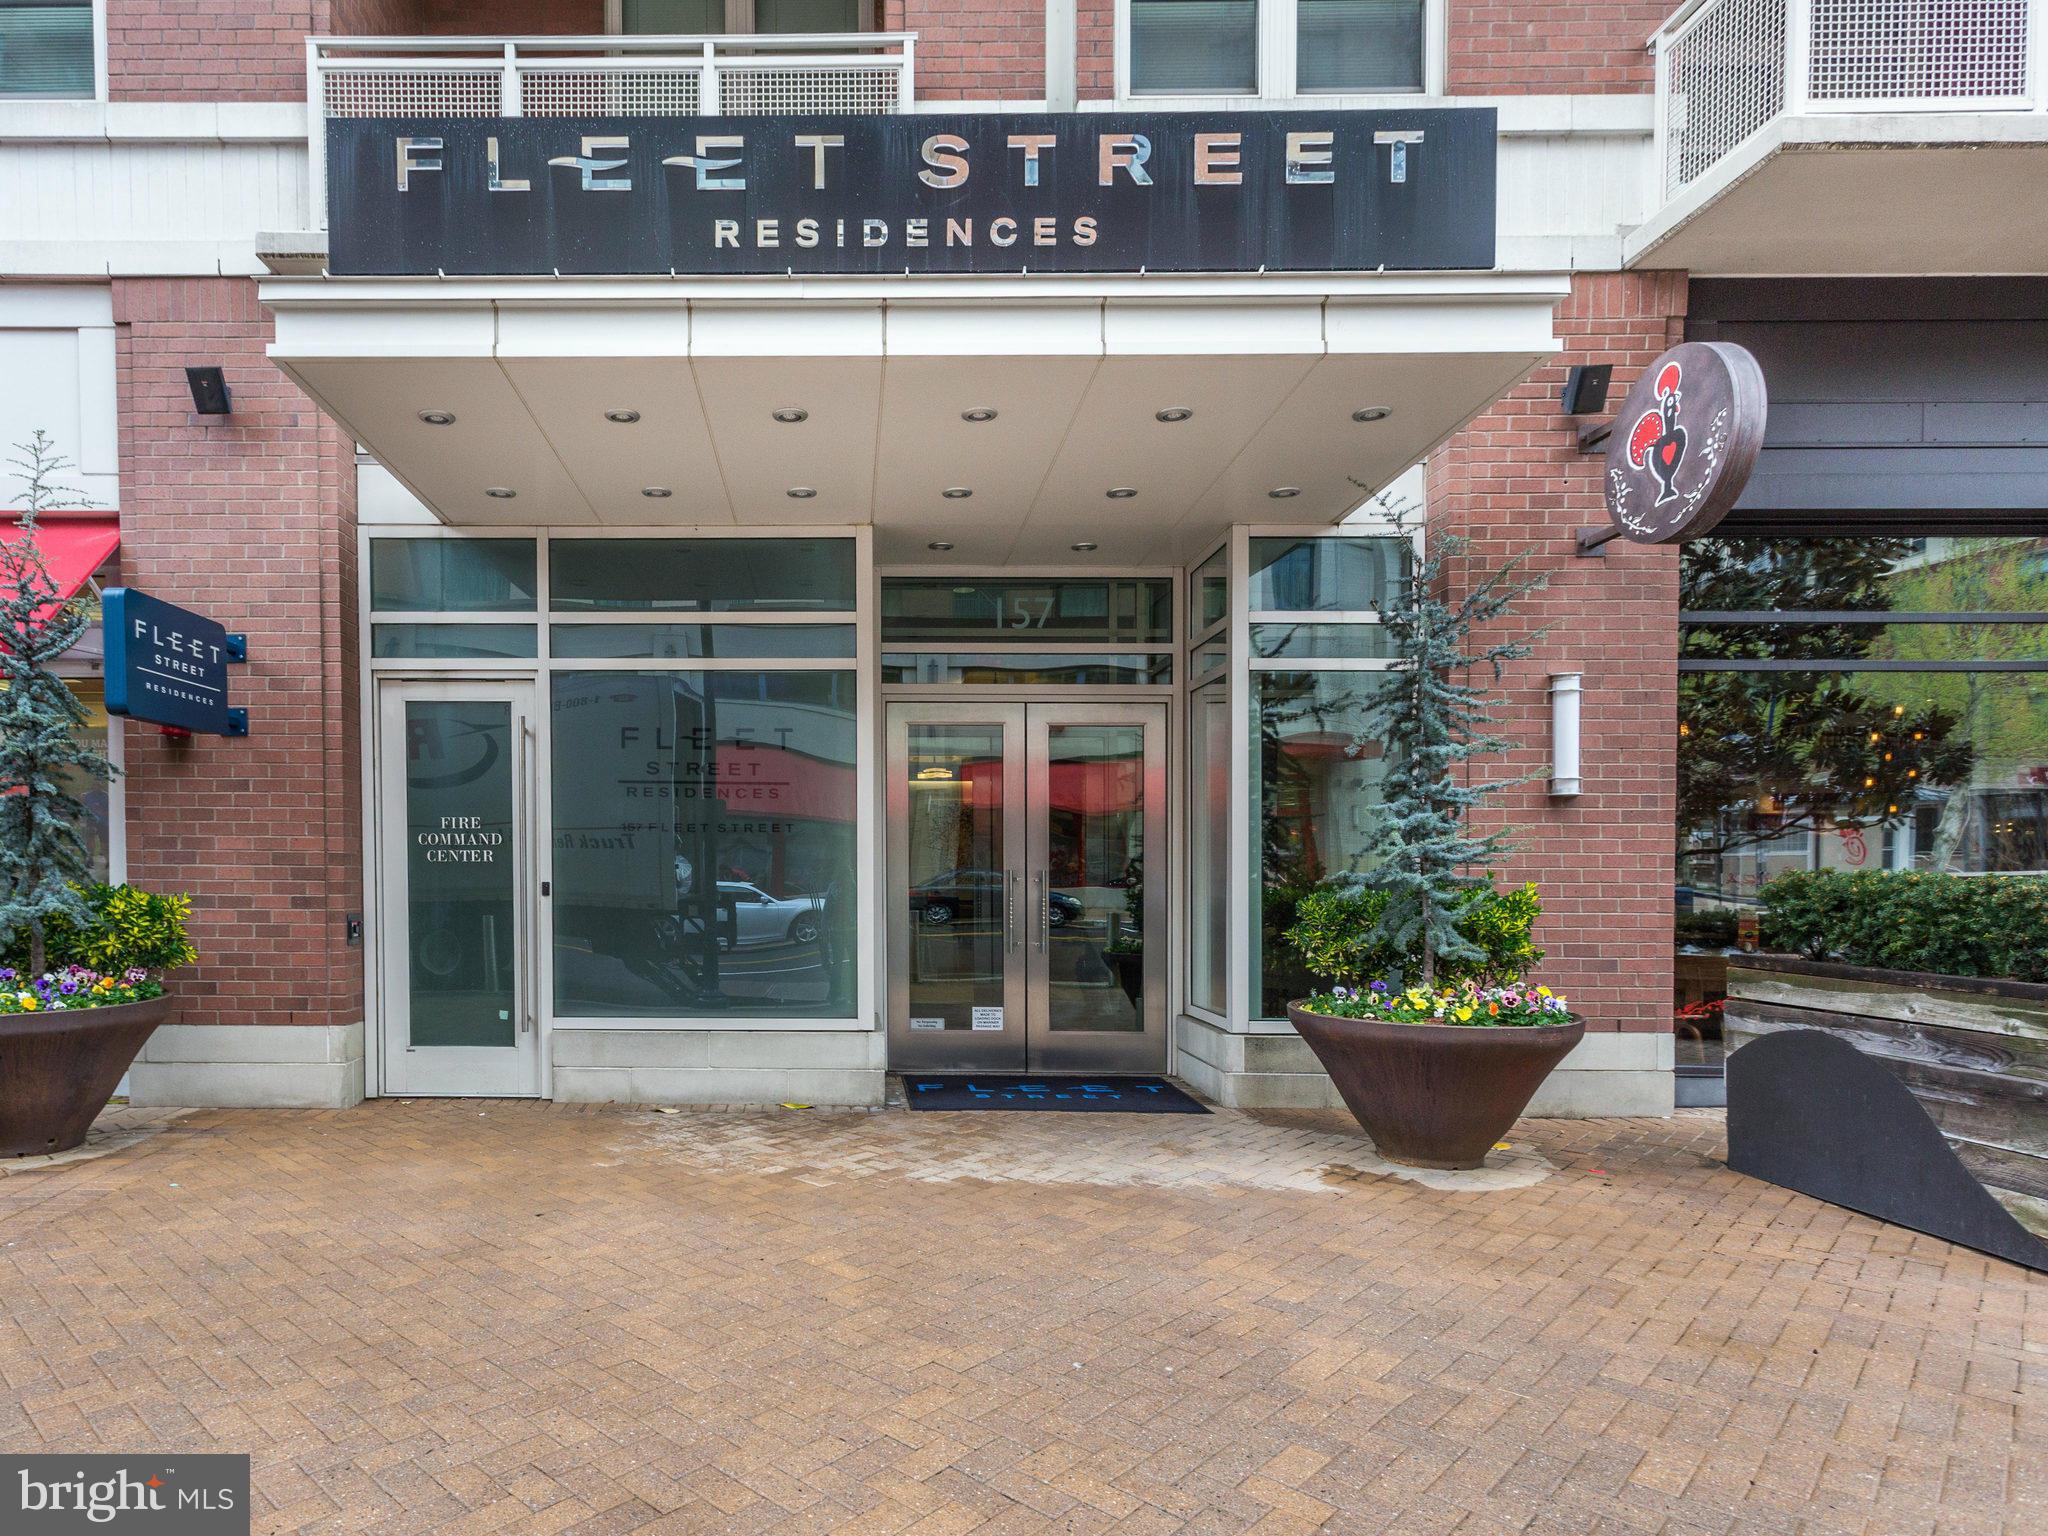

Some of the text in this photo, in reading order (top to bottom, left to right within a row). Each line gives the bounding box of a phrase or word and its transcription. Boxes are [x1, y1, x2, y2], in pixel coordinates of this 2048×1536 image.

[396, 130, 1425, 192] FLEET STREET
[713, 216, 1099, 250] RESIDENCES
[995, 596, 1056, 630] 157
[134, 618, 220, 664] FLEET
[154, 654, 205, 678] STREET
[145, 682, 214, 706] RESIDENCES
[620, 726, 794, 750] FLEET
[646, 761, 762, 777] STREET
[626, 786, 780, 800] RESIDENCES
[440, 816, 482, 830] FIRE
[648, 823, 709, 833] FLEET
[718, 823, 796, 834] STREET
[417, 832, 503, 847] COMMAND
[426, 849, 495, 864] CENTER
[916, 1083, 1165, 1094] FLEET
